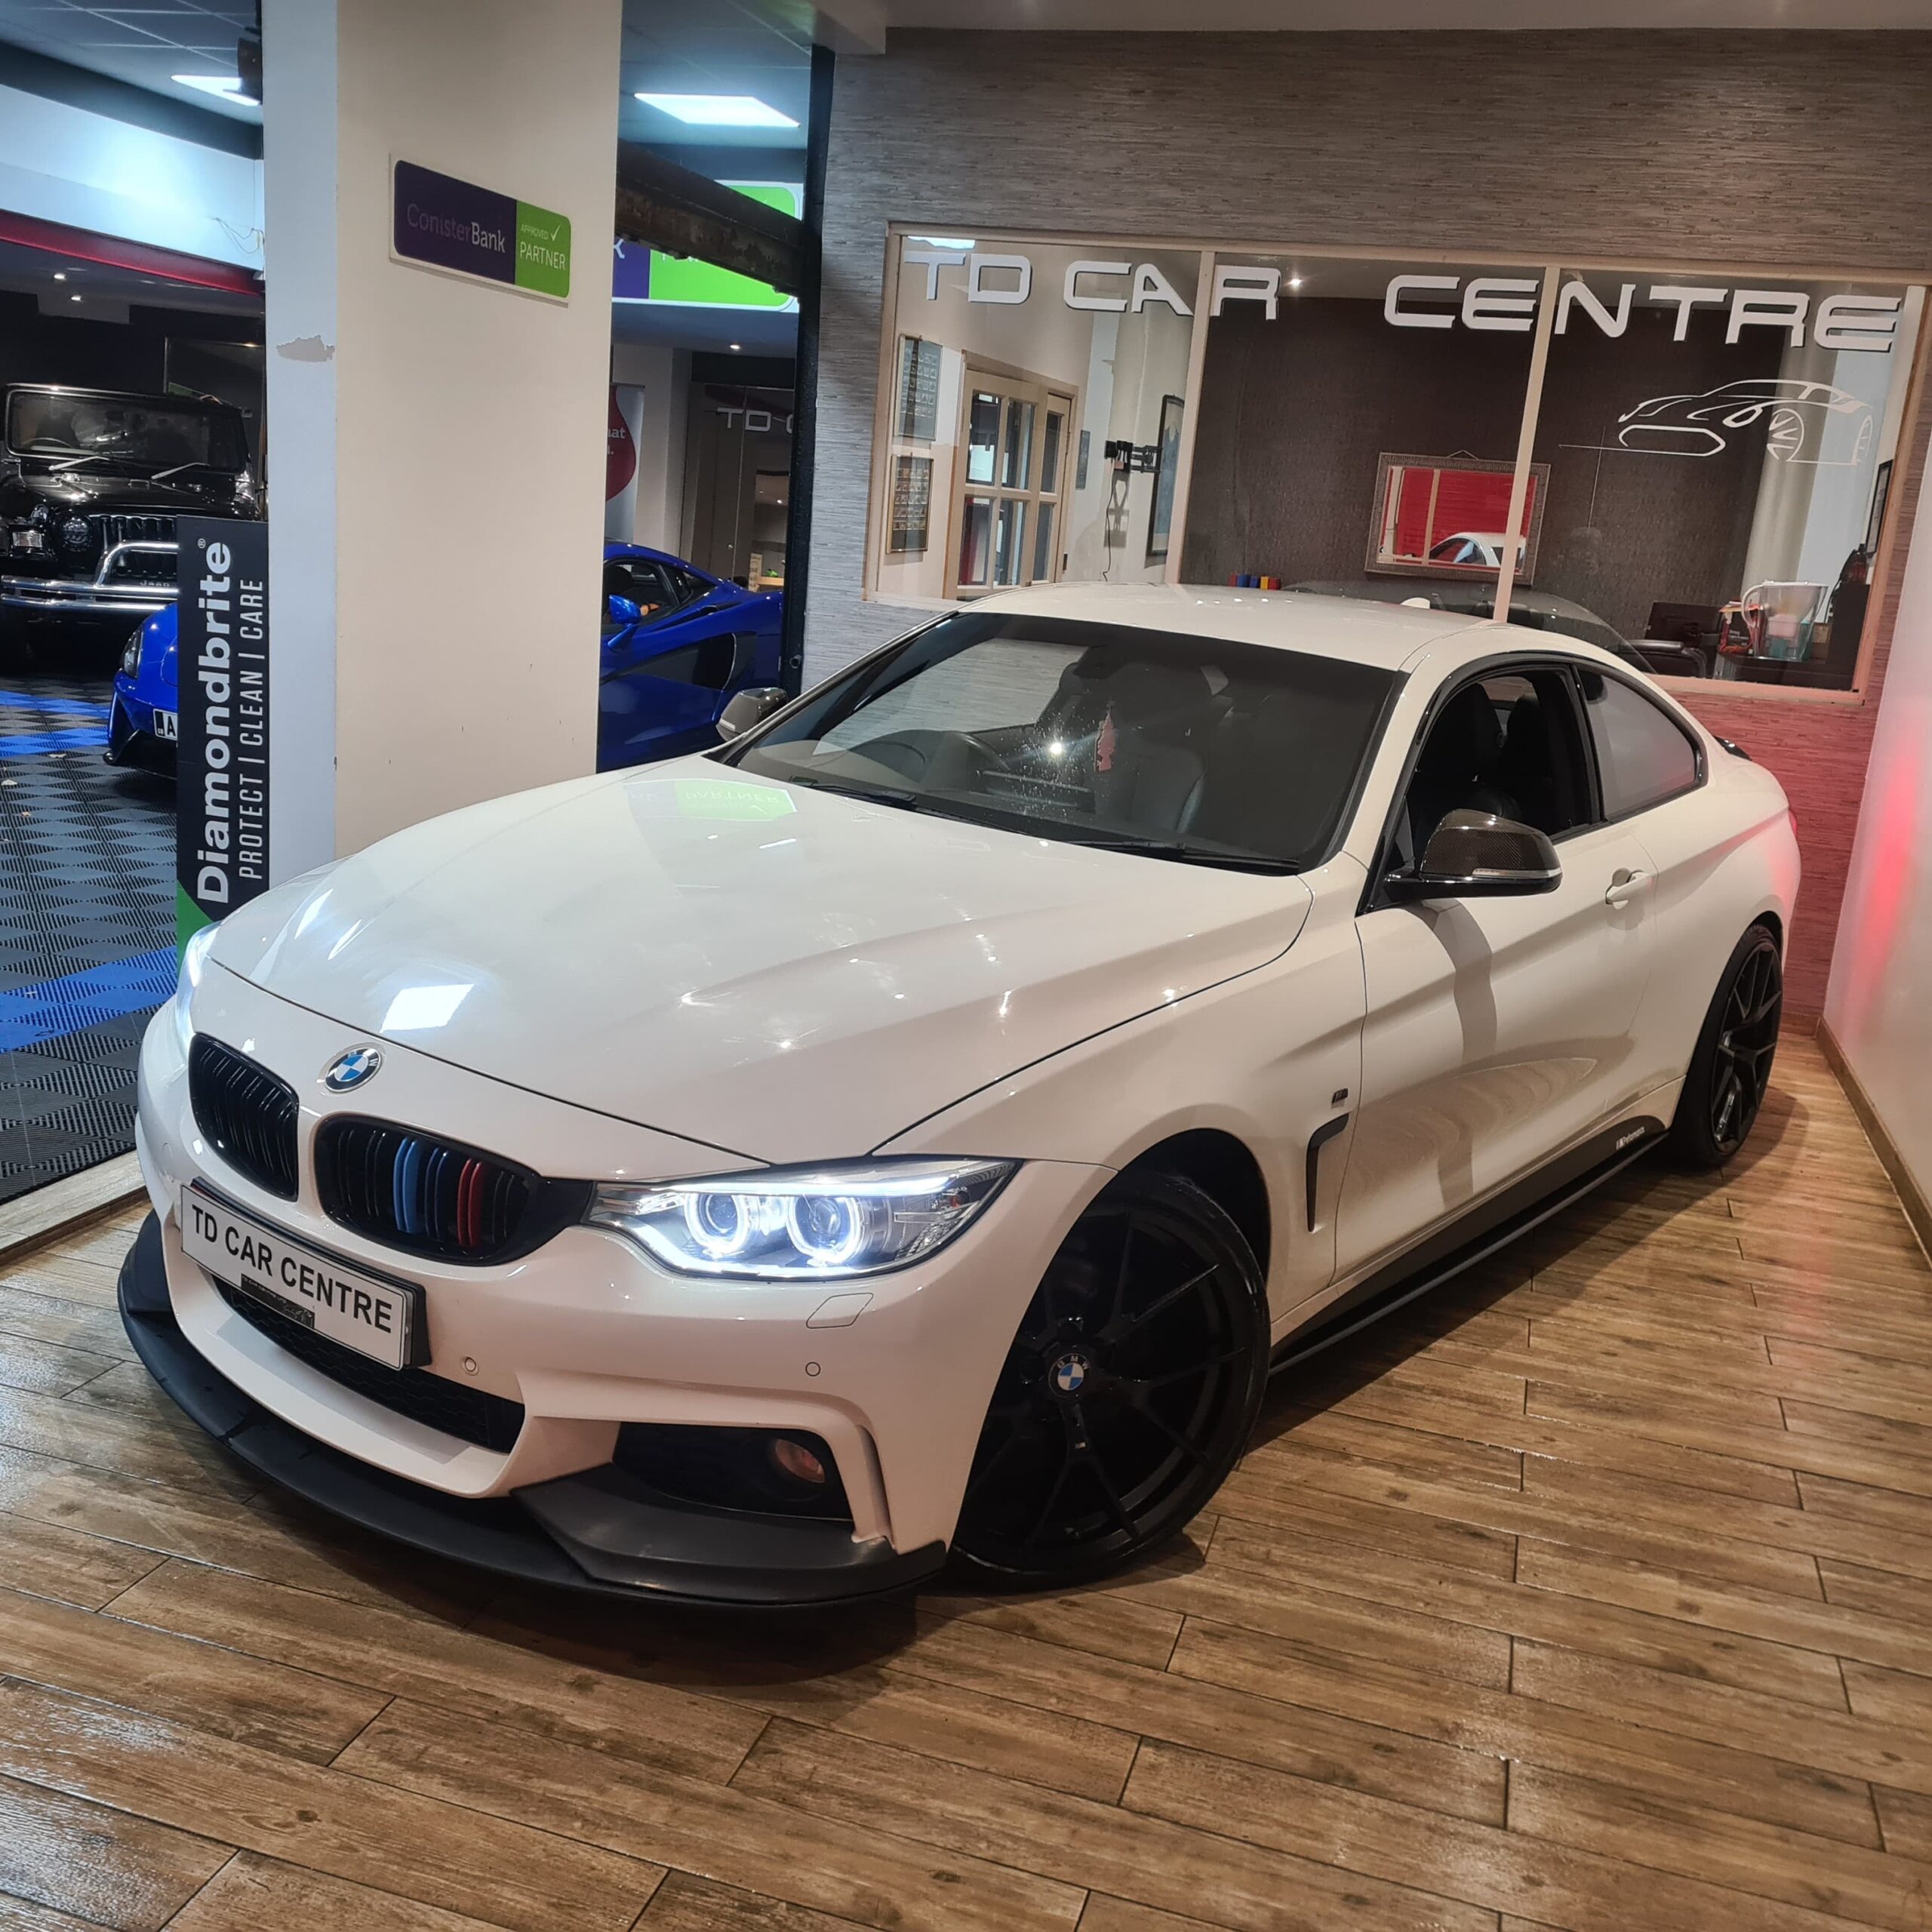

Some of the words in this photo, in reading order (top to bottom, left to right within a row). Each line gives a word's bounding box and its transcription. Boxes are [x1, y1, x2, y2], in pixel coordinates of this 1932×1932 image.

[407, 204, 505, 253] ConisterBank
[521, 223, 549, 240] APPROVED
[519, 242, 566, 270] PARTNER
[904, 250, 1032, 305] TD
[1063, 260, 1281, 321] CAR
[1384, 275, 1903, 352] CENTRE
[717, 408, 771, 432] TD
[239, 580, 263, 640] CARE
[239, 671, 263, 746] CLEAN
[238, 774, 263, 879] PROTECT
[192, 1204, 217, 1243] TD
[225, 1226, 272, 1277] CAR
[281, 1257, 392, 1334] CENTRE
[1057, 1355, 1091, 1370] BMW
